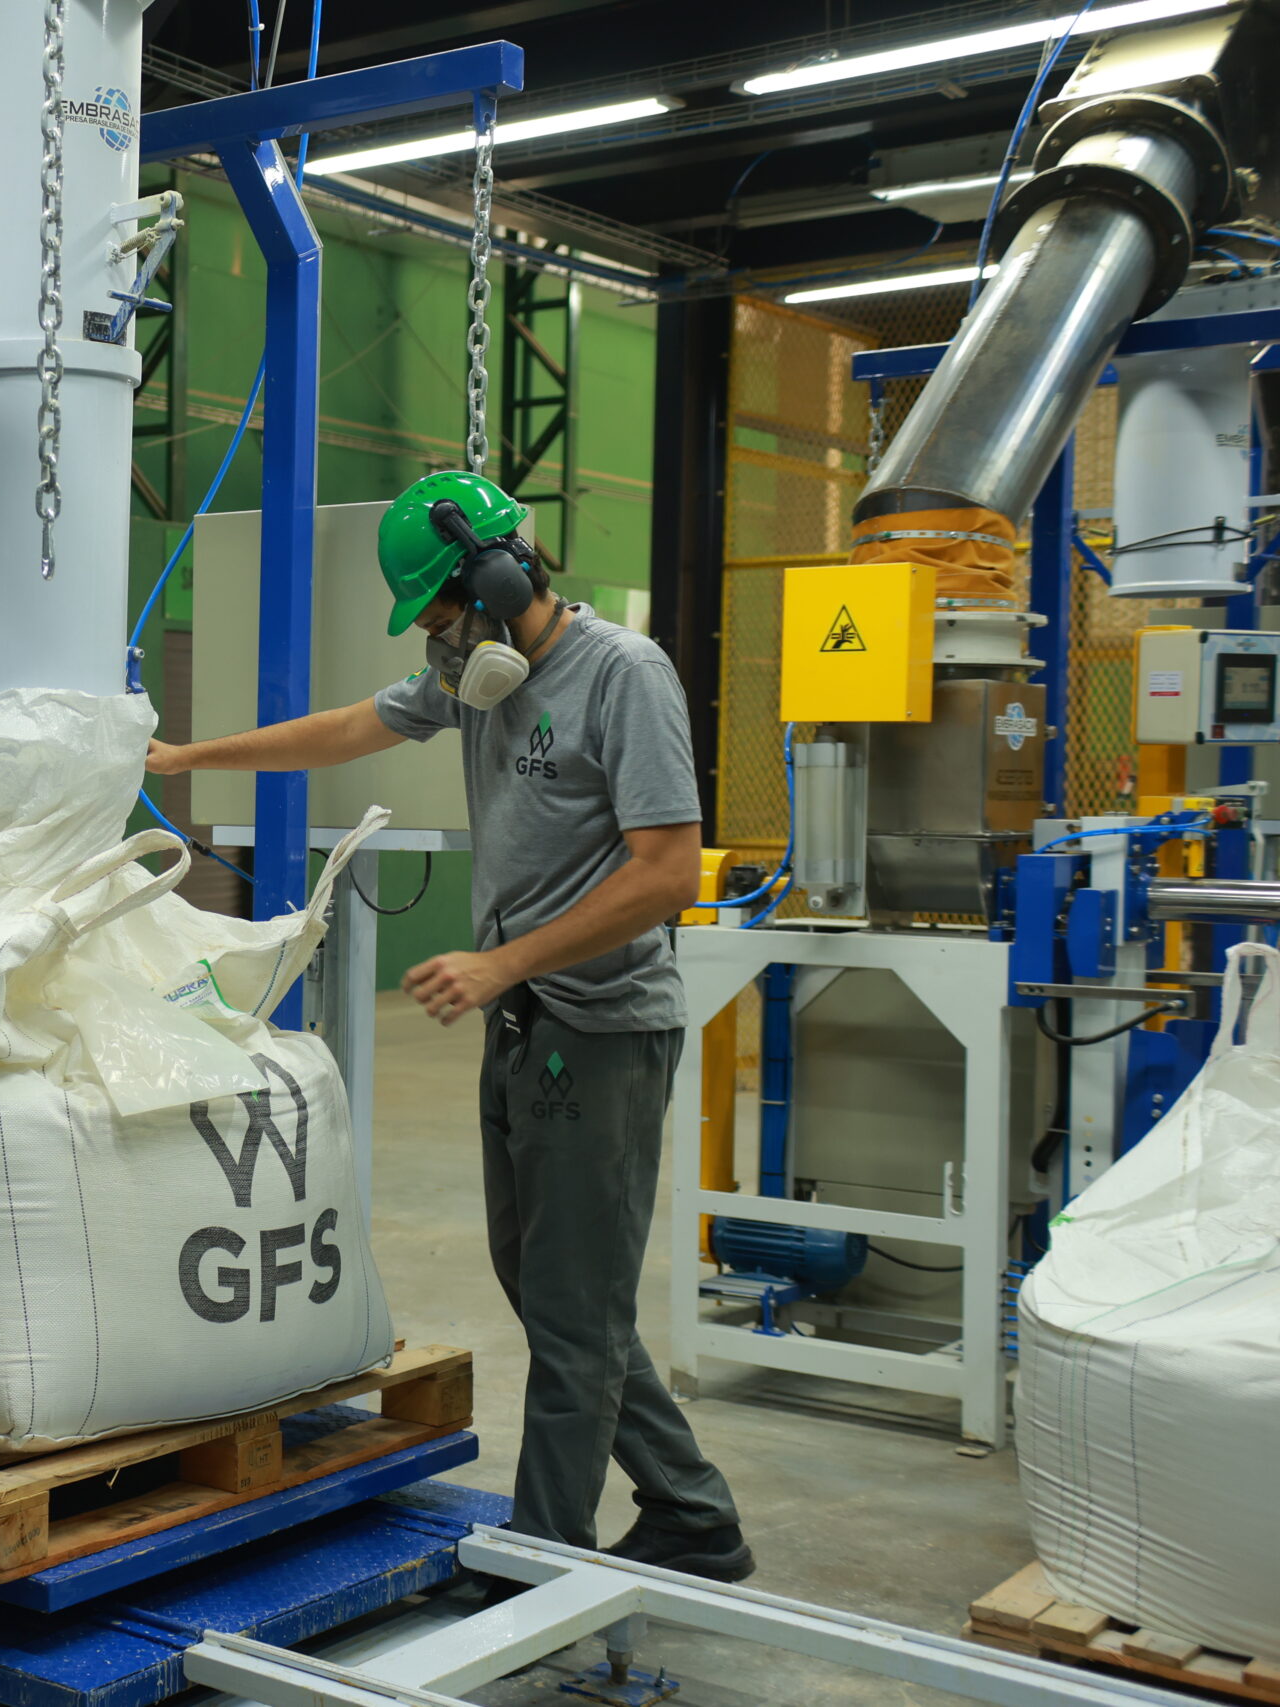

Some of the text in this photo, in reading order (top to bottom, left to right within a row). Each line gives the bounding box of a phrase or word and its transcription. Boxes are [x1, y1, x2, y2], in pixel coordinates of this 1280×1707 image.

[55, 114, 88, 124] EPRESA
[61, 100, 139, 130] EMBRASA
[516, 756, 558, 780] GFS
[531, 1100, 581, 1120] GFS
[178, 1207, 342, 1324] GFS
